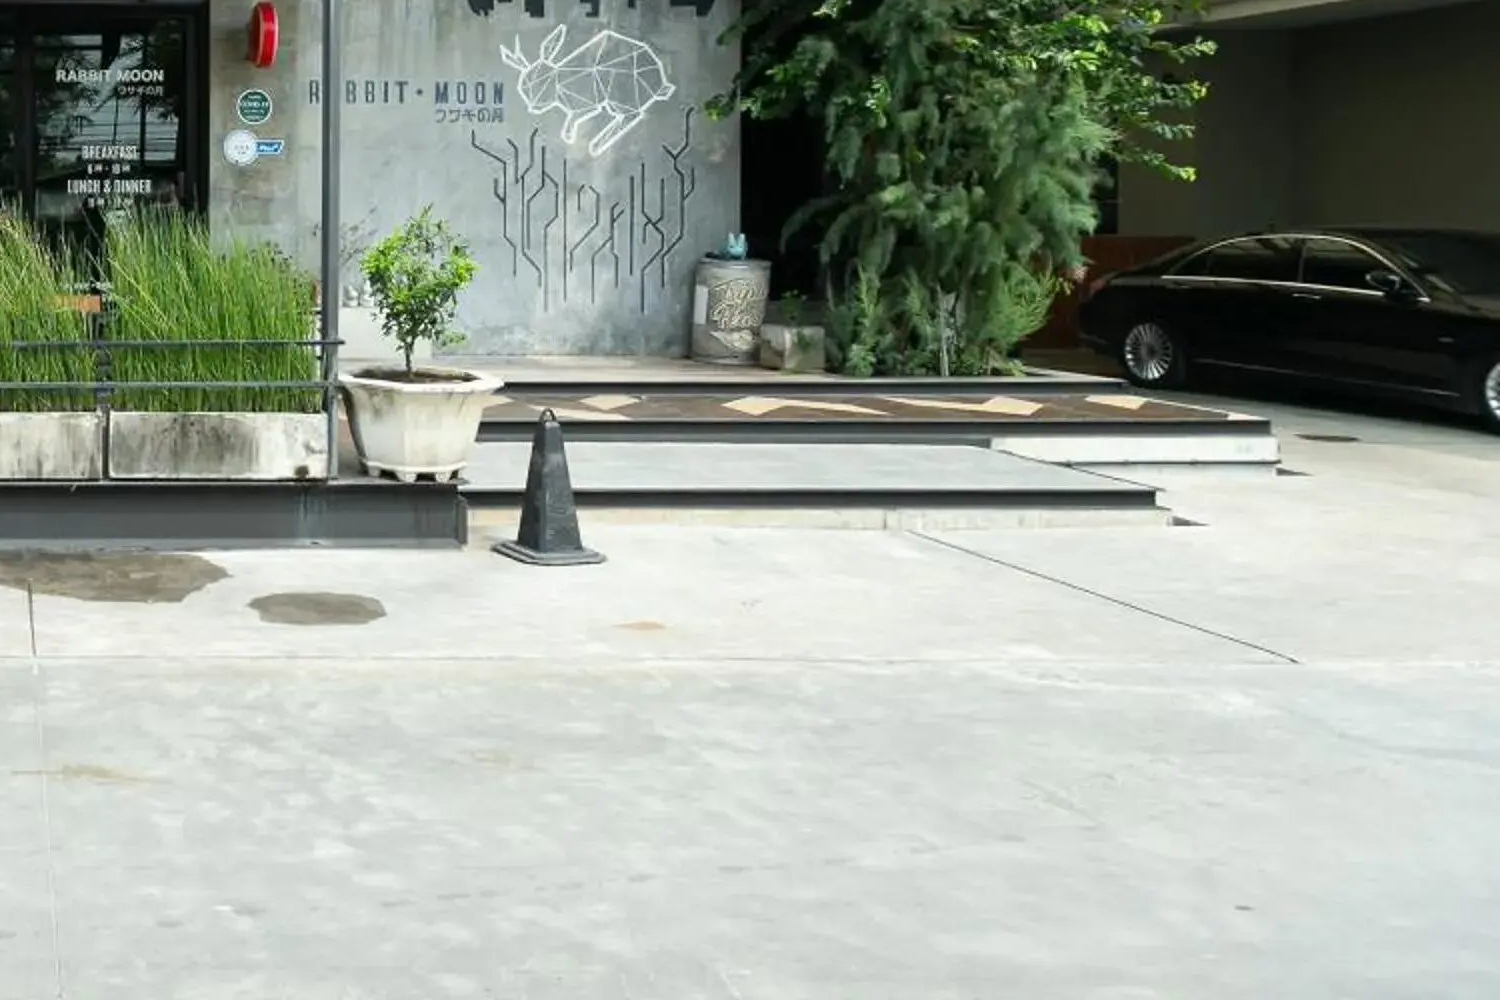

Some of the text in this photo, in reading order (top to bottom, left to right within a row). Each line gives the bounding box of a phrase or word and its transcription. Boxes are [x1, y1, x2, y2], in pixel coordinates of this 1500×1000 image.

[56, 69, 164, 82] RABBIT MOON
[309, 80, 504, 104] RBBIT MOON
[82, 145, 140, 160] BREAKFAST
[67, 179, 153, 193] LUNCH & DINNER
